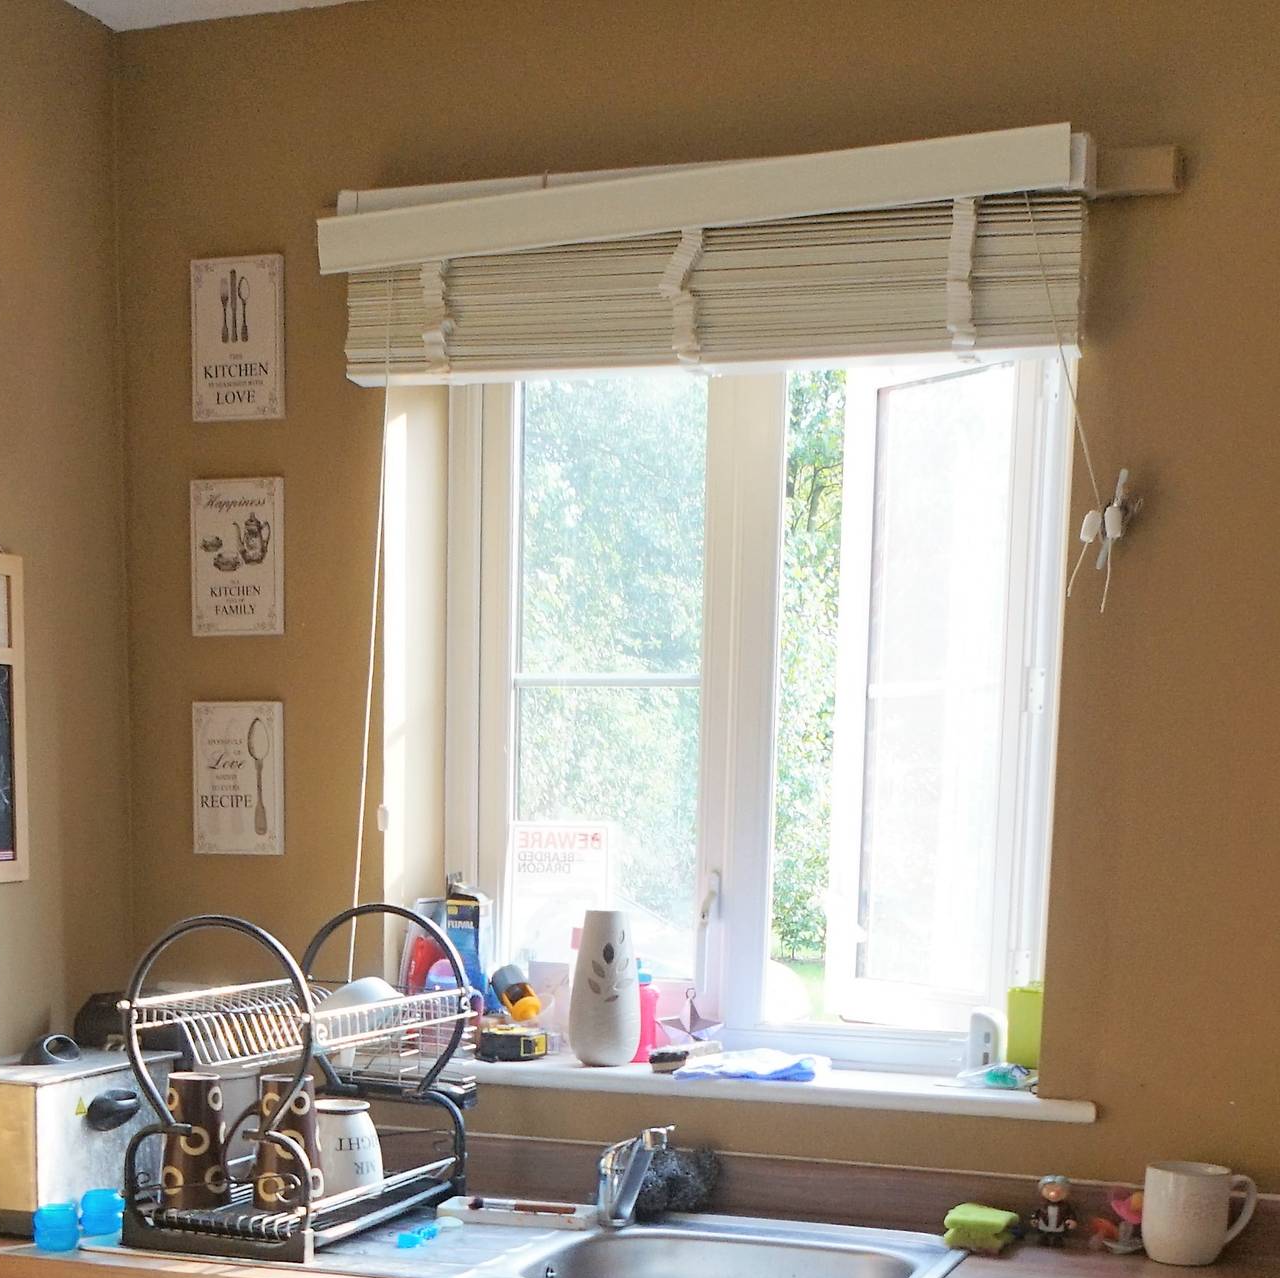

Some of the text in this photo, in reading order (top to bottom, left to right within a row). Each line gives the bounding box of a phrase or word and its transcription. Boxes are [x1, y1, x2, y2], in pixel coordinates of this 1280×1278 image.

[203, 362, 269, 379] KITCHEN
[216, 389, 256, 405] LOVE
[204, 495, 266, 512] Happiness
[210, 585, 261, 598] KITCHEN
[215, 604, 256, 616] FAMILY
[208, 753, 246, 770] Love
[200, 795, 253, 808] RECIPE
